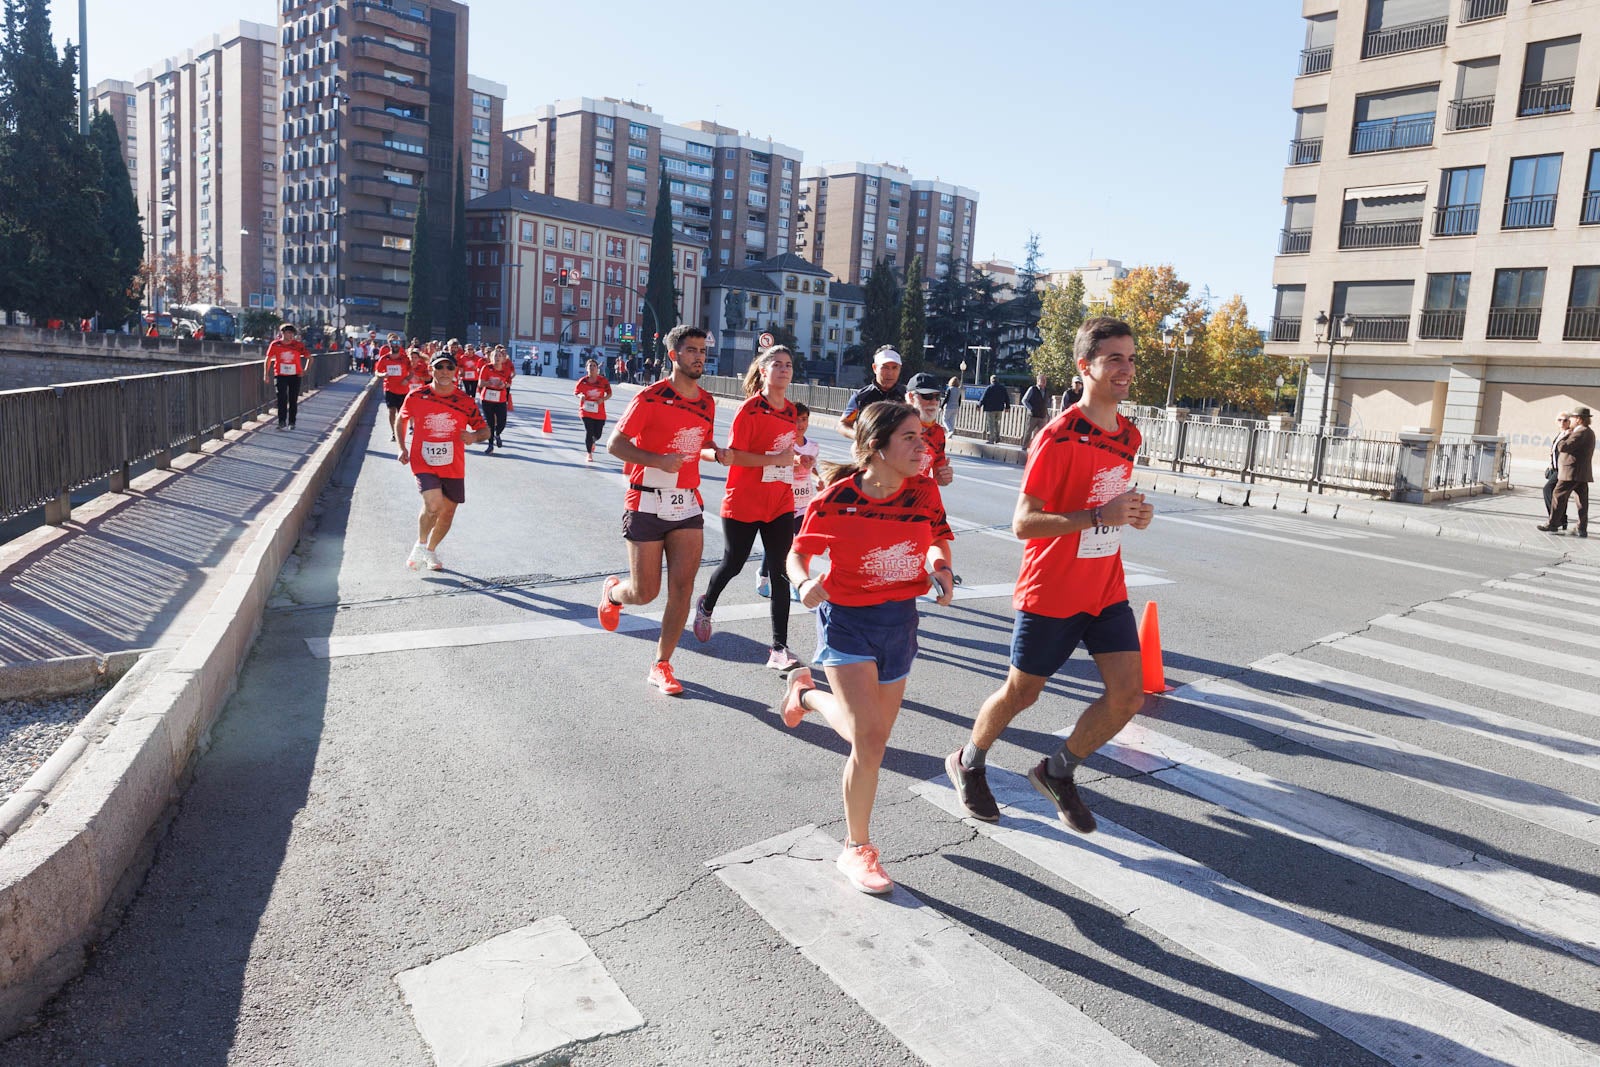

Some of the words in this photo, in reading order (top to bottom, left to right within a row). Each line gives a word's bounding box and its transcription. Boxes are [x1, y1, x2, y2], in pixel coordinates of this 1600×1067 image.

[625, 323, 633, 333] P
[426, 447, 448, 455] 1129
[670, 494, 684, 505] 28
[864, 556, 920, 571] carrera
